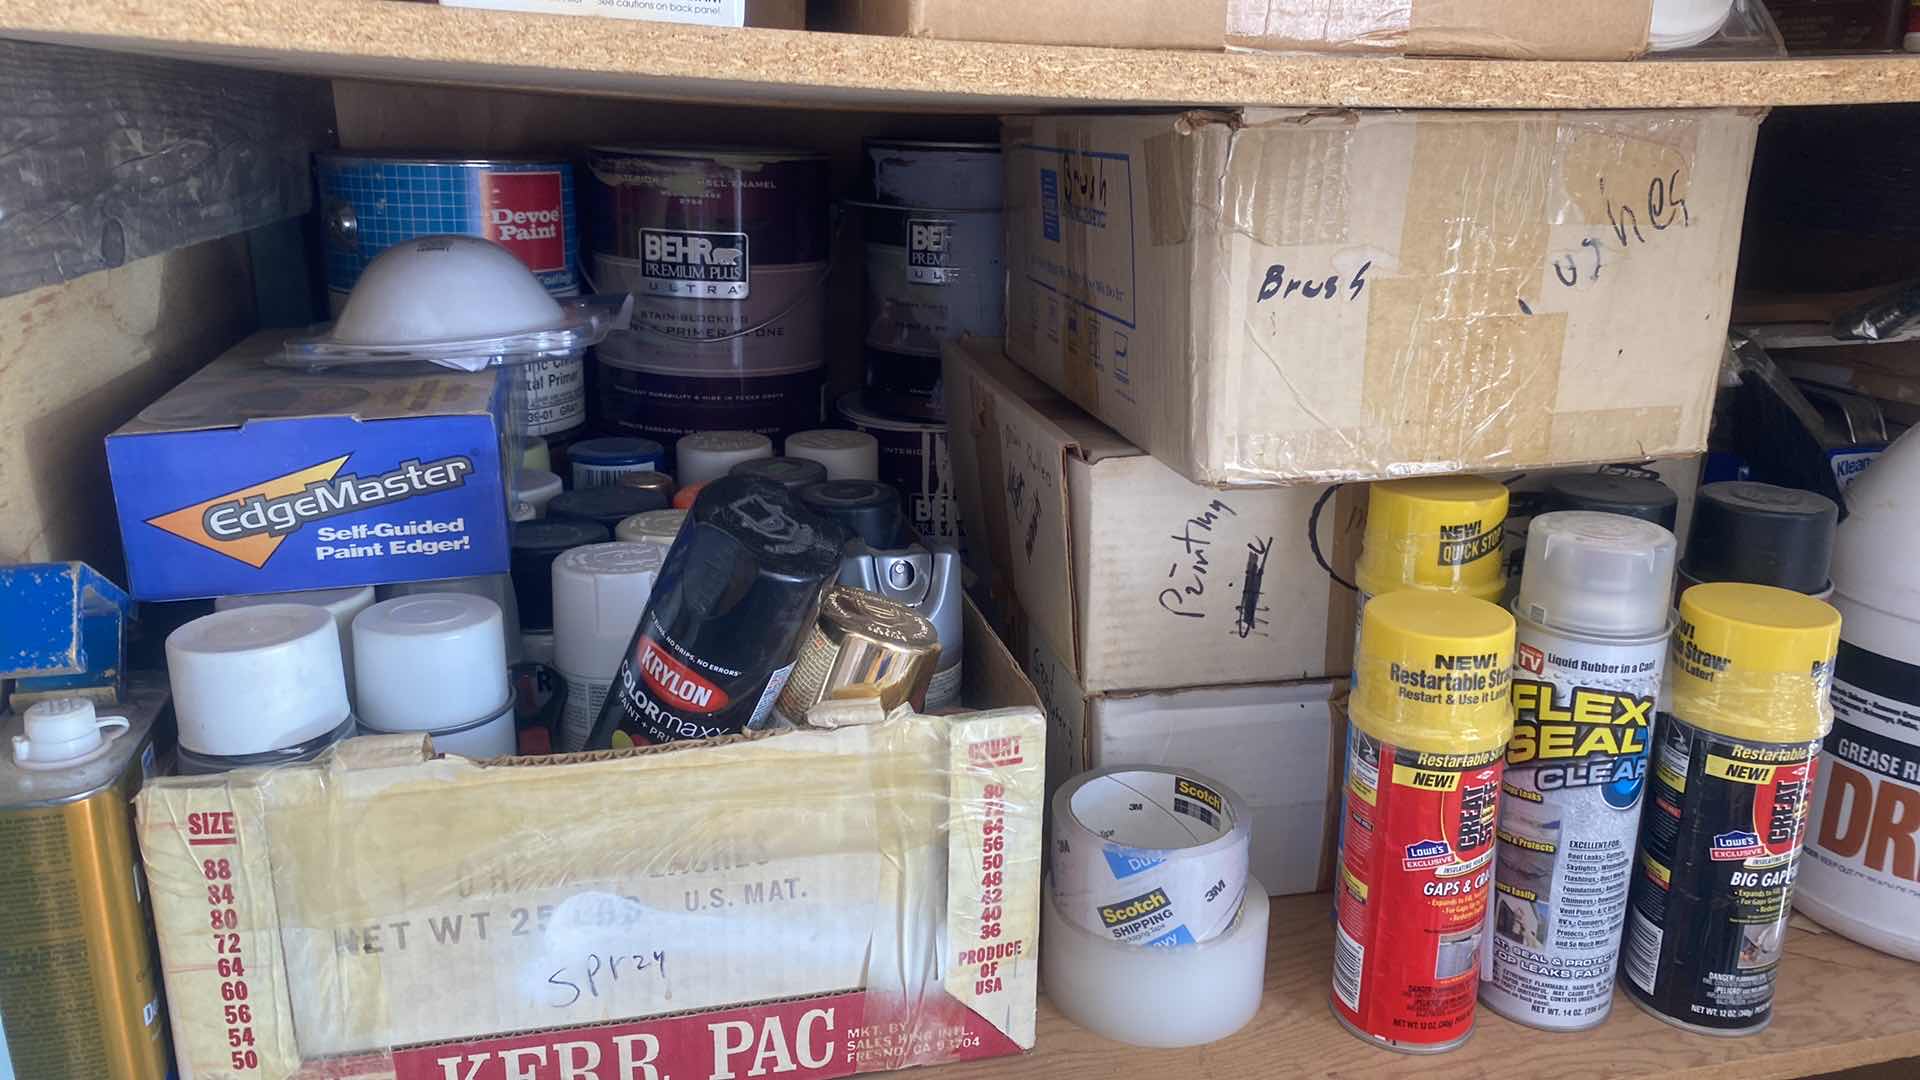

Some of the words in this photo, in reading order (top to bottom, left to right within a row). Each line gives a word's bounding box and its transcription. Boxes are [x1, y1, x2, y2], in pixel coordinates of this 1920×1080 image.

[670, 3, 693, 12] back
[500, 223, 556, 240] Paint
[645, 234, 713, 265] BEHR
[645, 263, 704, 278] PREMIUM
[710, 264, 742, 280] PLUS
[210, 458, 466, 536] EdgeMaster
[318, 518, 465, 541] Self-Guided
[1440, 520, 1482, 540] NEW!
[316, 543, 384, 561] Paint
[390, 536, 470, 558] Edger!
[1443, 538, 1480, 563] QUICK
[697, 658, 709, 668] NO
[1434, 653, 1498, 670] NEW!
[1520, 651, 1541, 671] TV
[1548, 653, 1579, 669] Liquid
[1580, 660, 1619, 674] Rubber
[1620, 663, 1630, 674] in
[1631, 666, 1638, 674] a
[642, 645, 713, 708] KRYLON
[1391, 663, 1486, 692] Restartable
[1398, 686, 1443, 705] Restart
[1446, 694, 1454, 704] &
[1459, 694, 1480, 704] Use
[1512, 683, 1653, 725] FLEX
[1507, 725, 1645, 765] SEAL
[1417, 753, 1488, 768] Restartable
[1839, 738, 1901, 775] GREASE
[1413, 772, 1456, 788] NEW!
[1725, 764, 1770, 781] NEW!
[1179, 781, 1220, 811] Scotch
[1129, 803, 1143, 812] 3M
[188, 812, 235, 835] SIZE
[983, 818, 1004, 836] 64
[983, 837, 1004, 854] 56
[1410, 845, 1445, 857] LOWE'S
[1569, 840, 1608, 849] EXCELLENT
[1719, 837, 1756, 848] LOWE'S
[982, 854, 1003, 871] 50
[1406, 856, 1454, 869] EXCLUSIVE
[1714, 848, 1762, 858] EXCLUSIVE
[203, 858, 232, 880] 88
[981, 872, 1002, 889] 48
[1423, 881, 1460, 896] GAPS
[1462, 879, 1472, 894] &
[1730, 872, 1759, 887] BIG
[207, 883, 234, 905] 84
[684, 889, 733, 912] U.S.
[744, 877, 807, 905] MAT.
[1205, 880, 1226, 903] 3M
[210, 908, 238, 930] 80
[981, 907, 1002, 923] 40
[1104, 895, 1166, 923] Scotch
[334, 922, 410, 957] NET
[429, 912, 490, 945] WT
[511, 906, 552, 937] 25
[980, 923, 1001, 940] 36
[1112, 909, 1174, 938] SHIPPING
[214, 933, 242, 954] 72
[958, 940, 1022, 966] PRODUCE
[1512, 945, 1548, 963] SEAL
[1552, 958, 1562, 966] &
[217, 957, 245, 978] 64
[980, 962, 998, 978] OF
[1521, 962, 1571, 978] LEAKS
[221, 981, 248, 1001] 60
[975, 977, 1002, 996] USA
[224, 1004, 251, 1024] 56
[1531, 1004, 1545, 1014] NET
[1547, 1006, 1561, 1016] WT.
[1563, 1008, 1572, 1016] 14
[1691, 1004, 1705, 1014] NET
[228, 1027, 255, 1047] 54
[847, 1025, 882, 1039] MKT.
[889, 1022, 906, 1034] BY
[707, 1007, 835, 1080] PAC
[847, 1035, 892, 1051] SALES
[913, 1043, 931, 1055] CA
[231, 1050, 258, 1070] 50
